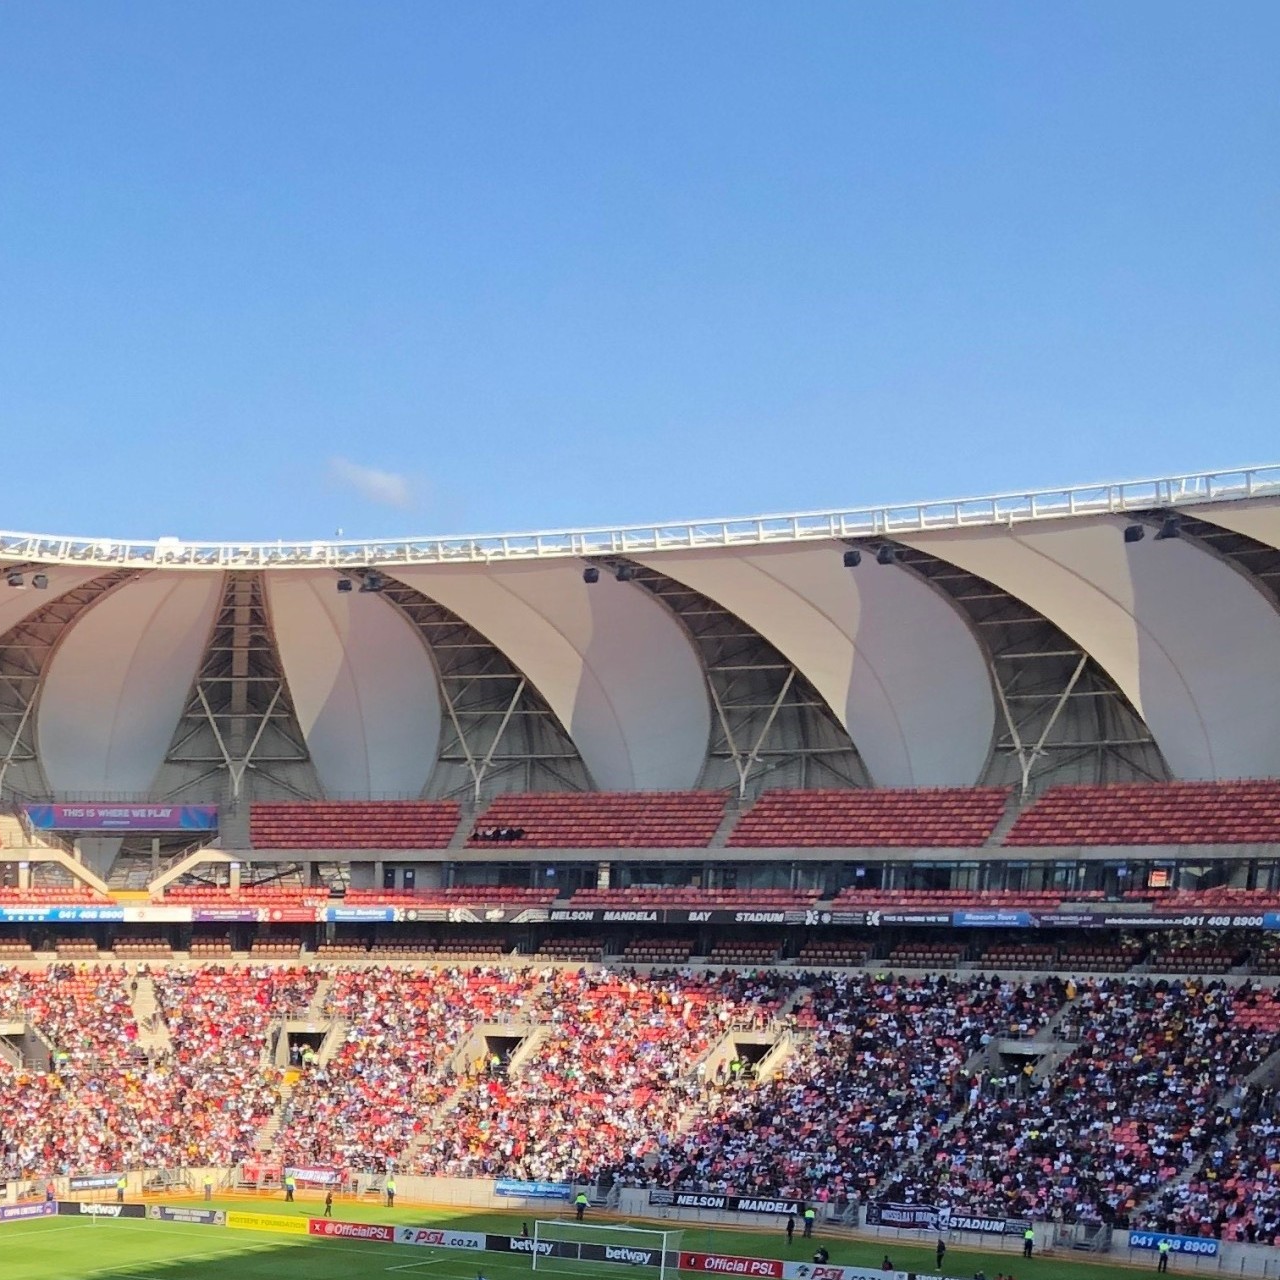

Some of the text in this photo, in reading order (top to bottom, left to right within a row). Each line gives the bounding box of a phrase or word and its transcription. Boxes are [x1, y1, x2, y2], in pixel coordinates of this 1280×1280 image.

[551, 911, 785, 923] NELSON MANDELA BAY STADIUM
[1183, 916, 1263, 926] 041 408 8900
[80, 1203, 123, 1217] betway
[677, 1195, 1006, 1232] NELSON MANDELA STADIUM
[325, 1222, 390, 1240] @OfficialPSL
[1131, 1235, 1154, 1247] 041
[1183, 1241, 1217, 1254] 8900
[606, 1246, 652, 1265] betway
[704, 1257, 747, 1273] Official
[750, 1261, 776, 1275] PSL
